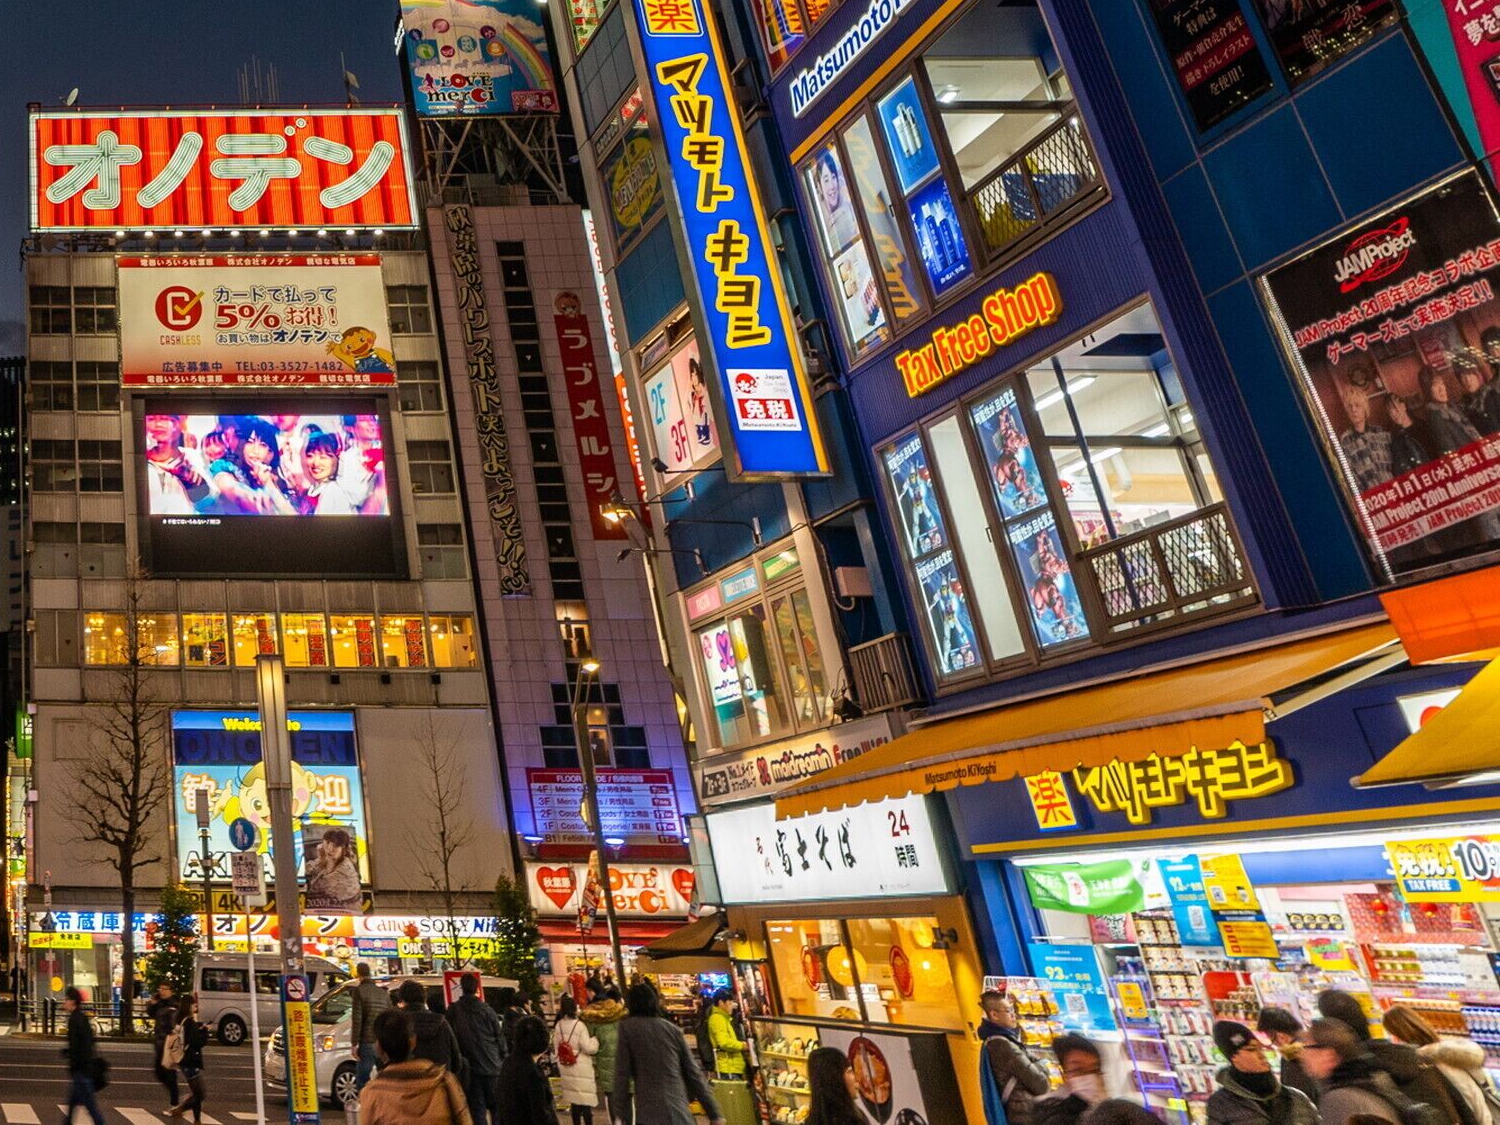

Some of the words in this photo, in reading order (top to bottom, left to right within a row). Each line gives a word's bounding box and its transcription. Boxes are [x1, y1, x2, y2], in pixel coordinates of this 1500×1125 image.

[43, 117, 396, 212] オノデン
[657, 53, 772, 349] マツモトキヨシ
[214, 286, 338, 304] カードで払って
[216, 304, 281, 329] 5%
[285, 306, 339, 328] お得!
[1295, 326, 1320, 349] JAM
[1319, 307, 1362, 338] Project
[159, 335, 202, 346] CASHLESS
[899, 347, 939, 398] Tax
[935, 309, 991, 378] Free
[985, 275, 1056, 348] Shop
[162, 361, 223, 373] 広告募集中
[235, 361, 344, 373] TEL:03-3527-1482
[651, 381, 667, 426] 2F
[744, 400, 789, 420] 免税
[670, 418, 688, 463] 3F
[180, 731, 350, 765] ONOEN
[771, 743, 833, 784] maidreamin
[925, 765, 967, 786] Matsumoto
[315, 775, 353, 815] 迎
[1029, 775, 1075, 826] 薬
[887, 809, 911, 838] 24
[894, 844, 920, 869] 時間
[1407, 879, 1427, 892] TAX
[1426, 879, 1452, 891] FREE
[420, 918, 471, 933] SONY
